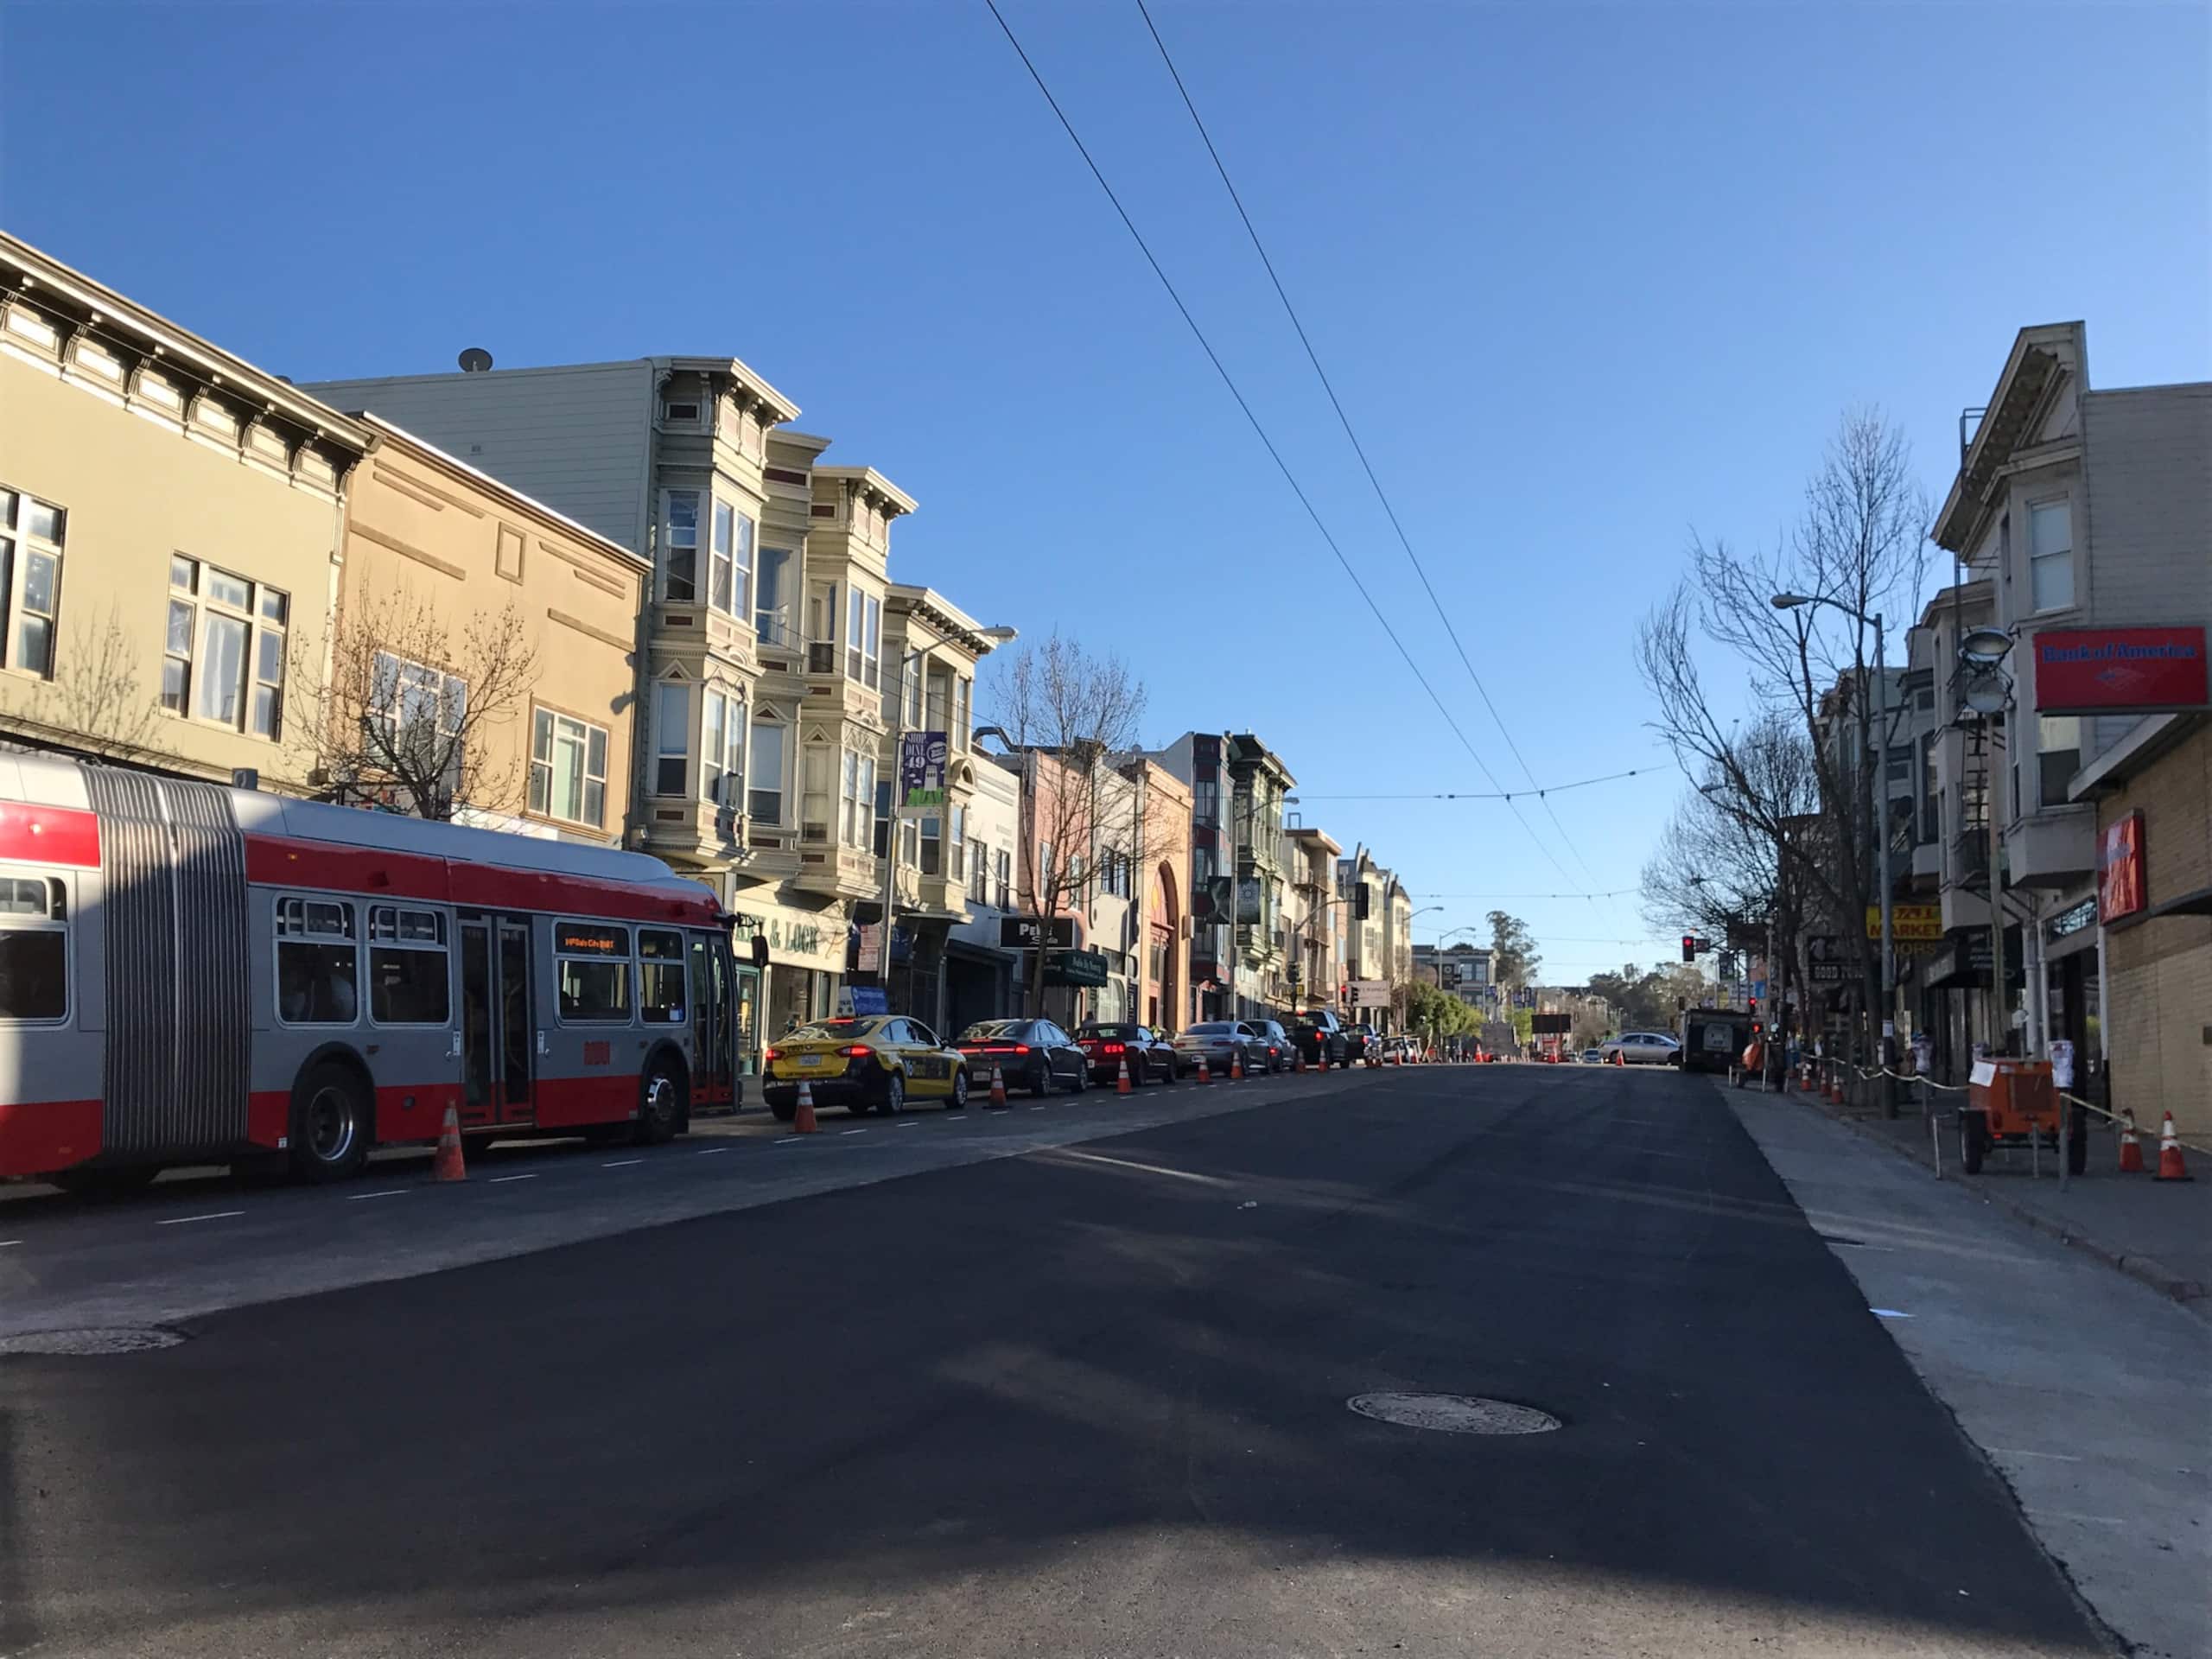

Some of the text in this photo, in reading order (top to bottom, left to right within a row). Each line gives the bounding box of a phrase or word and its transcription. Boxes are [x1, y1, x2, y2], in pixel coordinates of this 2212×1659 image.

[2043, 641, 2196, 664] Bank of America
[906, 733, 927, 744] SHOP
[906, 744, 926, 756] DINE
[906, 756, 925, 768] 49
[785, 921, 820, 956] LOCK
